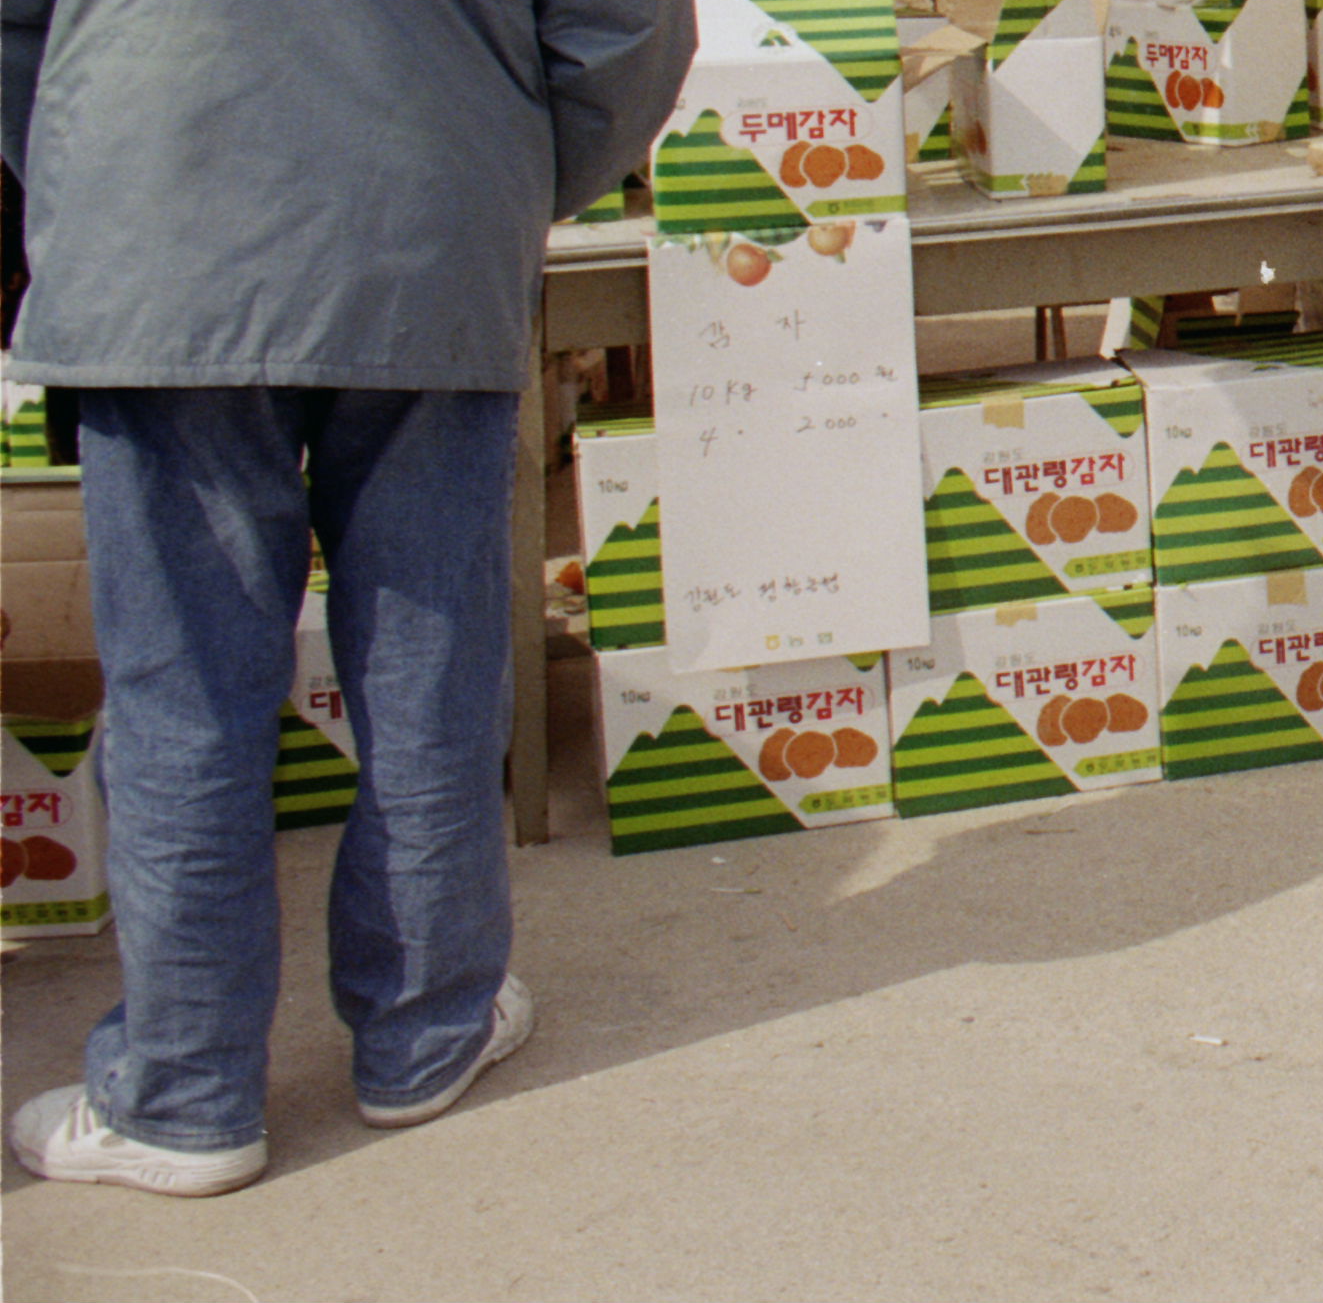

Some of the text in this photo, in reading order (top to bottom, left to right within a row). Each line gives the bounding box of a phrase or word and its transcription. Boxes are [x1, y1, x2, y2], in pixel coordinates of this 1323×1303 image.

[1145, 42, 1208, 70] 두메감자
[738, 108, 858, 142] 두메감자
[983, 452, 1127, 495] 대관령감자
[995, 653, 1138, 698] 대관령감자
[715, 685, 867, 732] 대관령감자
